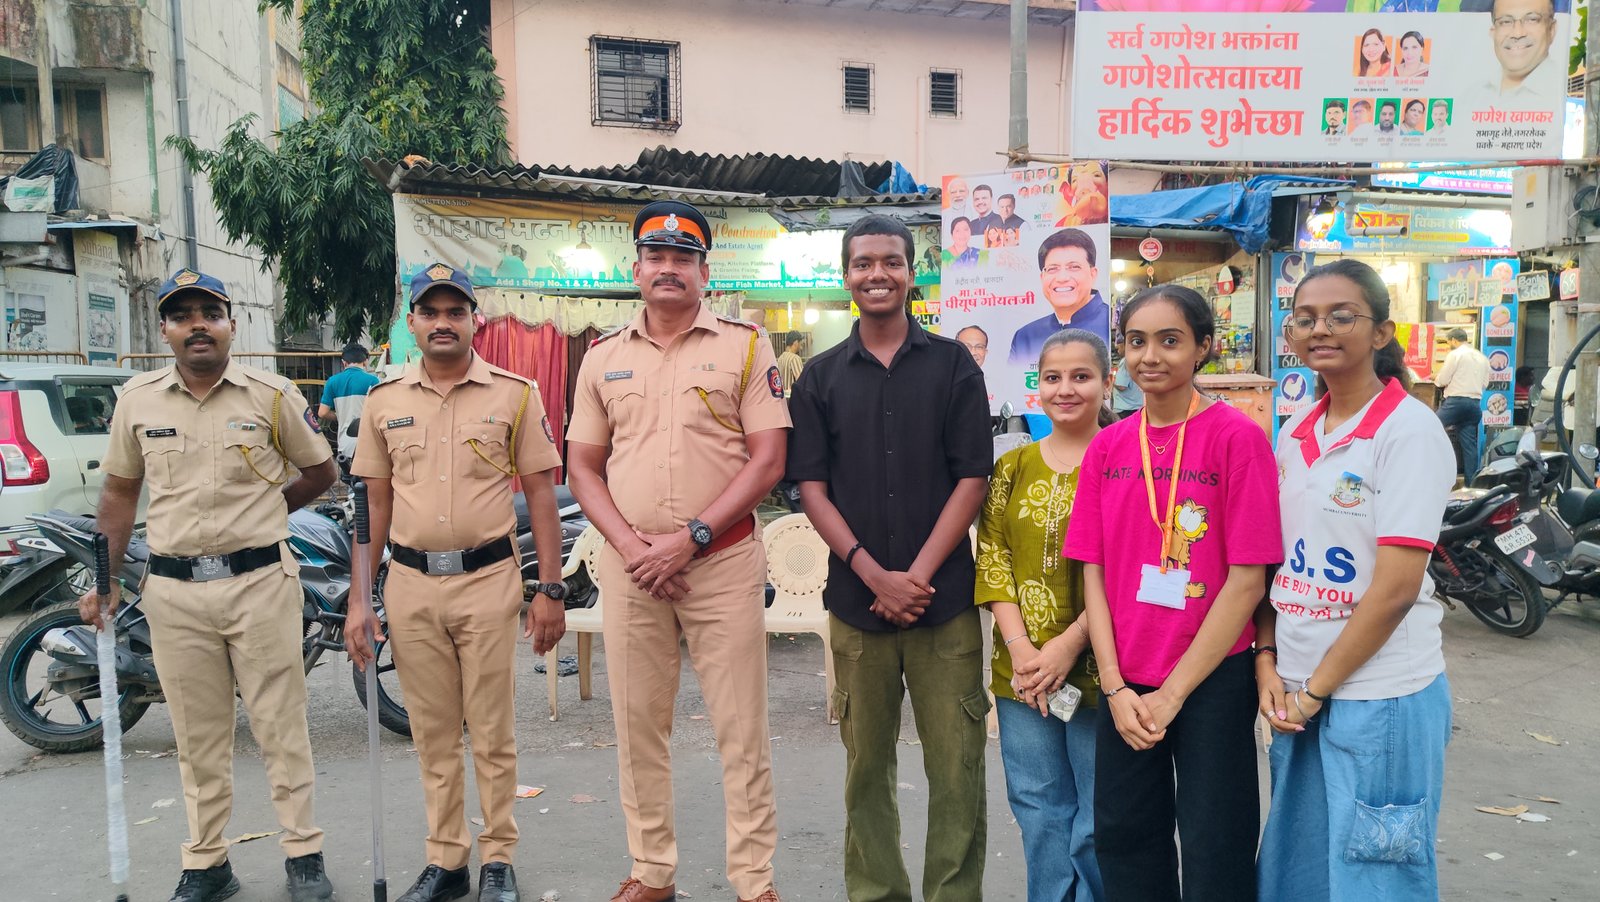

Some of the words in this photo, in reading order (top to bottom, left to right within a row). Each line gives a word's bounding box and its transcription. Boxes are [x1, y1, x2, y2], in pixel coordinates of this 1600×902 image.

[1107, 23, 1145, 49] सर्व
[1150, 24, 1216, 50] गणेश
[1222, 24, 1299, 50] भक्तांना
[1103, 54, 1303, 90] गणेशोत्सवाच्या
[1098, 97, 1192, 140] हार्दिक
[1200, 98, 1304, 148] शुभेच्छा
[1471, 107, 1507, 123] गणेश
[1510, 111, 1554, 123] खणकर
[414, 213, 506, 242] आझाद
[509, 217, 572, 241] मटन
[576, 215, 630, 243] शॉप
[721, 224, 777, 239] Construction
[522, 279, 545, 288] Shop
[715, 281, 734, 289] Near
[736, 281, 752, 289] Fish
[945, 296, 977, 313] पीयूष
[980, 290, 1035, 306] गोयलजी
[1441, 293, 1466, 308] 260
[1483, 416, 1510, 424] LOLIPOP
[1103, 467, 1132, 480] HATE
[1275, 574, 1290, 588] ME
[1292, 579, 1312, 596] BUT
[1316, 586, 1353, 605] YOU
